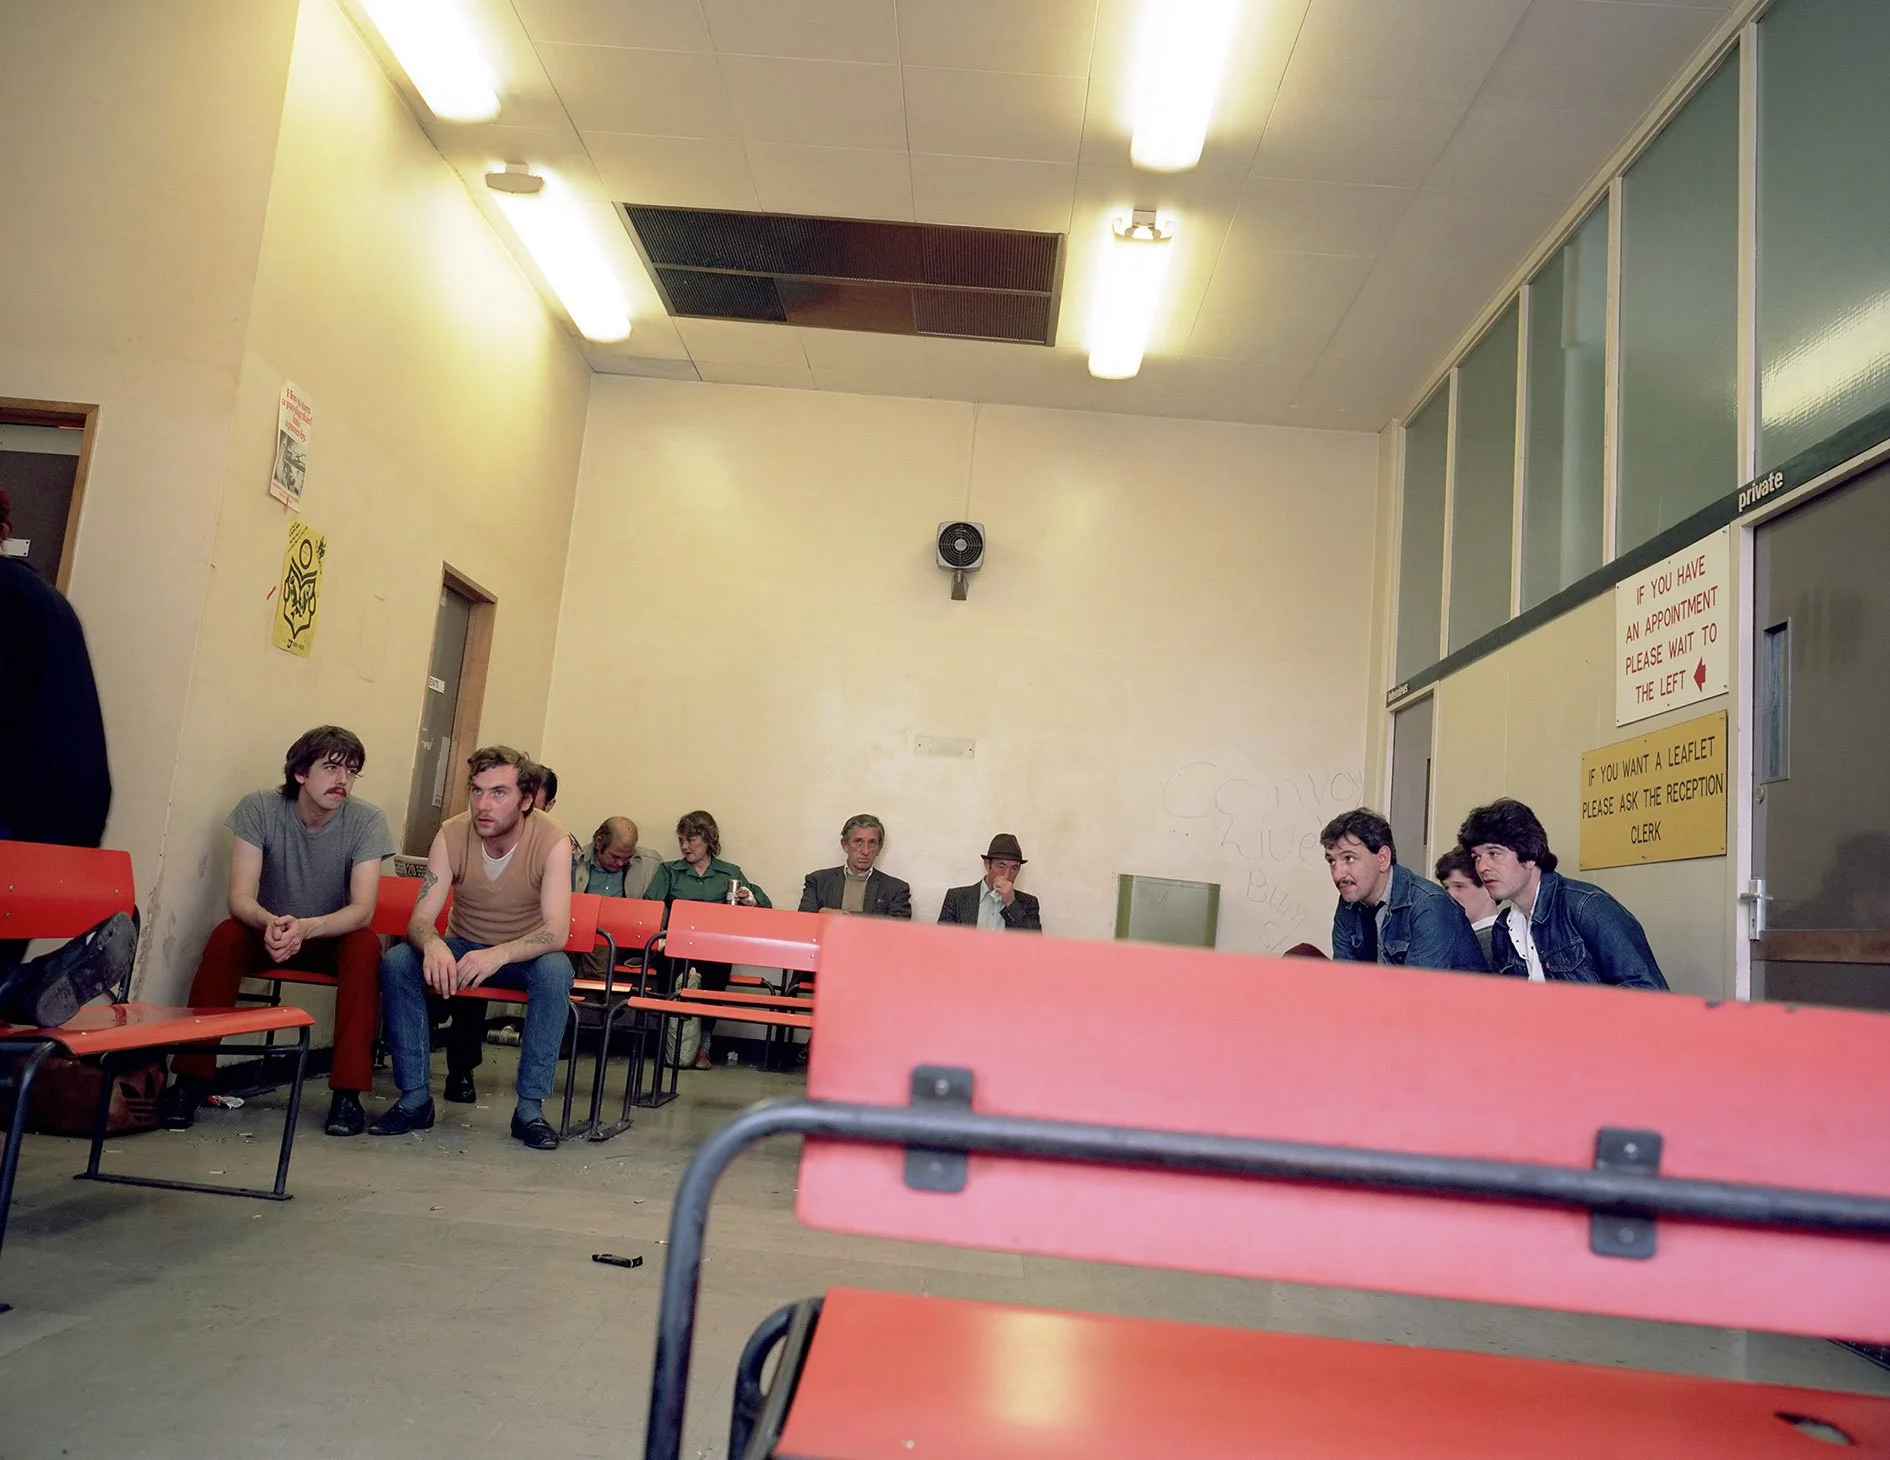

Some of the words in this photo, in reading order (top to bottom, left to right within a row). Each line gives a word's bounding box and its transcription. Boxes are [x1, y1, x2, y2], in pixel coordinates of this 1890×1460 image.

[1738, 471, 1784, 513] private
[1636, 585, 1645, 606] IF
[1651, 572, 1672, 598] YOU
[1677, 554, 1706, 587] HAVE
[1626, 621, 1640, 644] AN
[1645, 585, 1718, 636] APPOINTMENT
[1626, 644, 1663, 675] PLEASE
[1668, 631, 1694, 659] WAIT
[1701, 622, 1717, 646] TO
[1635, 681, 1654, 704] THE
[1660, 669, 1686, 696] LEFT
[1588, 768, 1596, 787] IF
[1600, 762, 1619, 783] YOU
[1622, 754, 1650, 778] WANT
[1655, 751, 1662, 771] A
[1668, 735, 1715, 767] LEAFLET
[1582, 796, 1614, 820] PLEASE
[1619, 791, 1638, 813] ASK
[1643, 786, 1662, 808] THE
[1666, 773, 1723, 804] RECEPTION
[1630, 821, 1662, 844] CLERK
